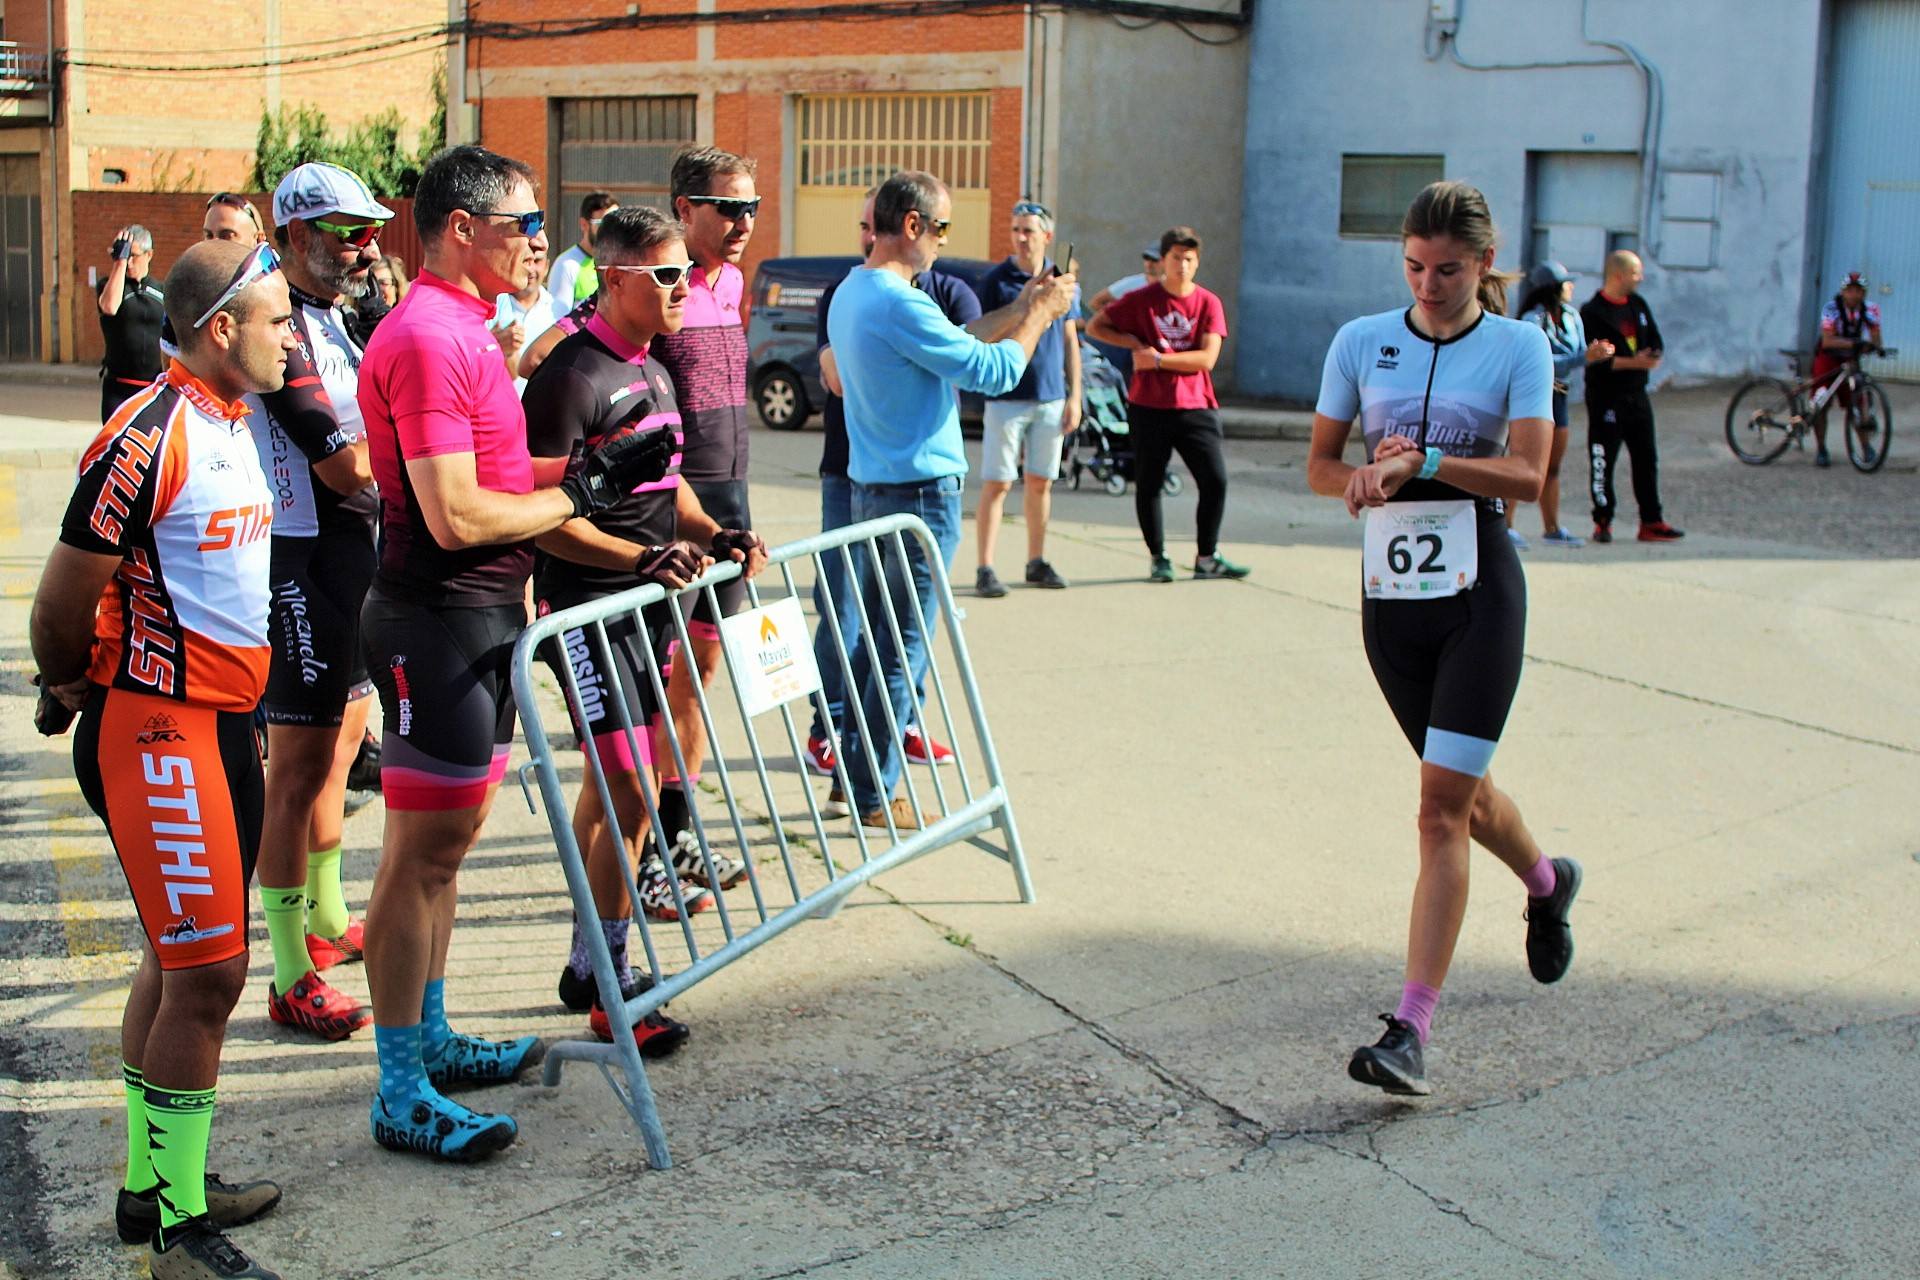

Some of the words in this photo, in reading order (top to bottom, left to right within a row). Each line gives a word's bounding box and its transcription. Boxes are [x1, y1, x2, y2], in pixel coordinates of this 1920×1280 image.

[278, 186, 325, 215] KAS
[90, 426, 164, 546] STIHL
[274, 455, 295, 512] ROGER
[197, 503, 273, 552] STIH
[1387, 533, 1446, 575] 62
[117, 546, 175, 695] STIHL
[280, 610, 295, 662] BODEGAS
[141, 752, 214, 917] STIHL
